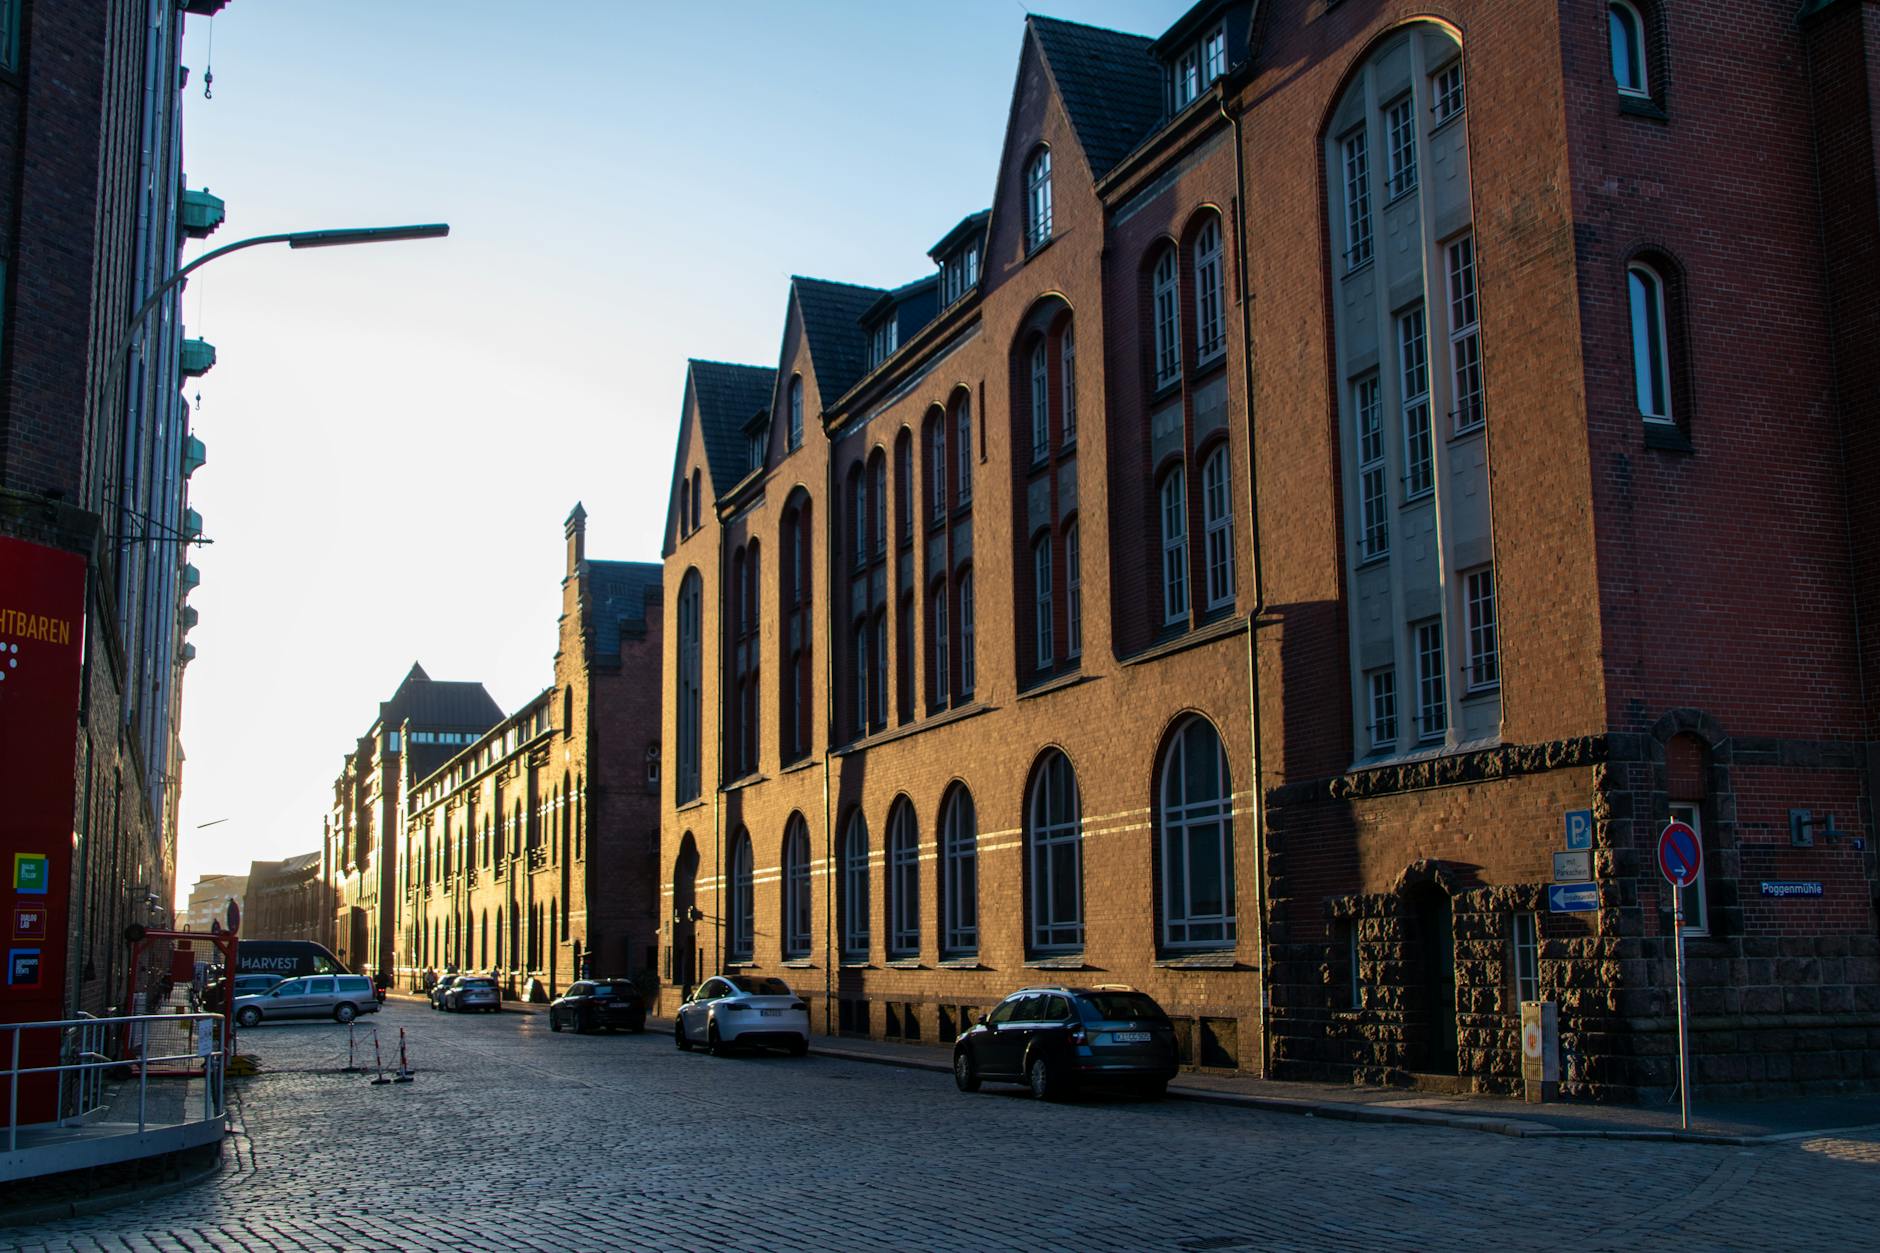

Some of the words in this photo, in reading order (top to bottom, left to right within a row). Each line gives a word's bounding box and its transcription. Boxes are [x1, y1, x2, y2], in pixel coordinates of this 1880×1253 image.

[1571, 816, 1585, 845] P
[1762, 883, 1822, 896] Poggenmühle
[242, 957, 298, 969] HARVEST
